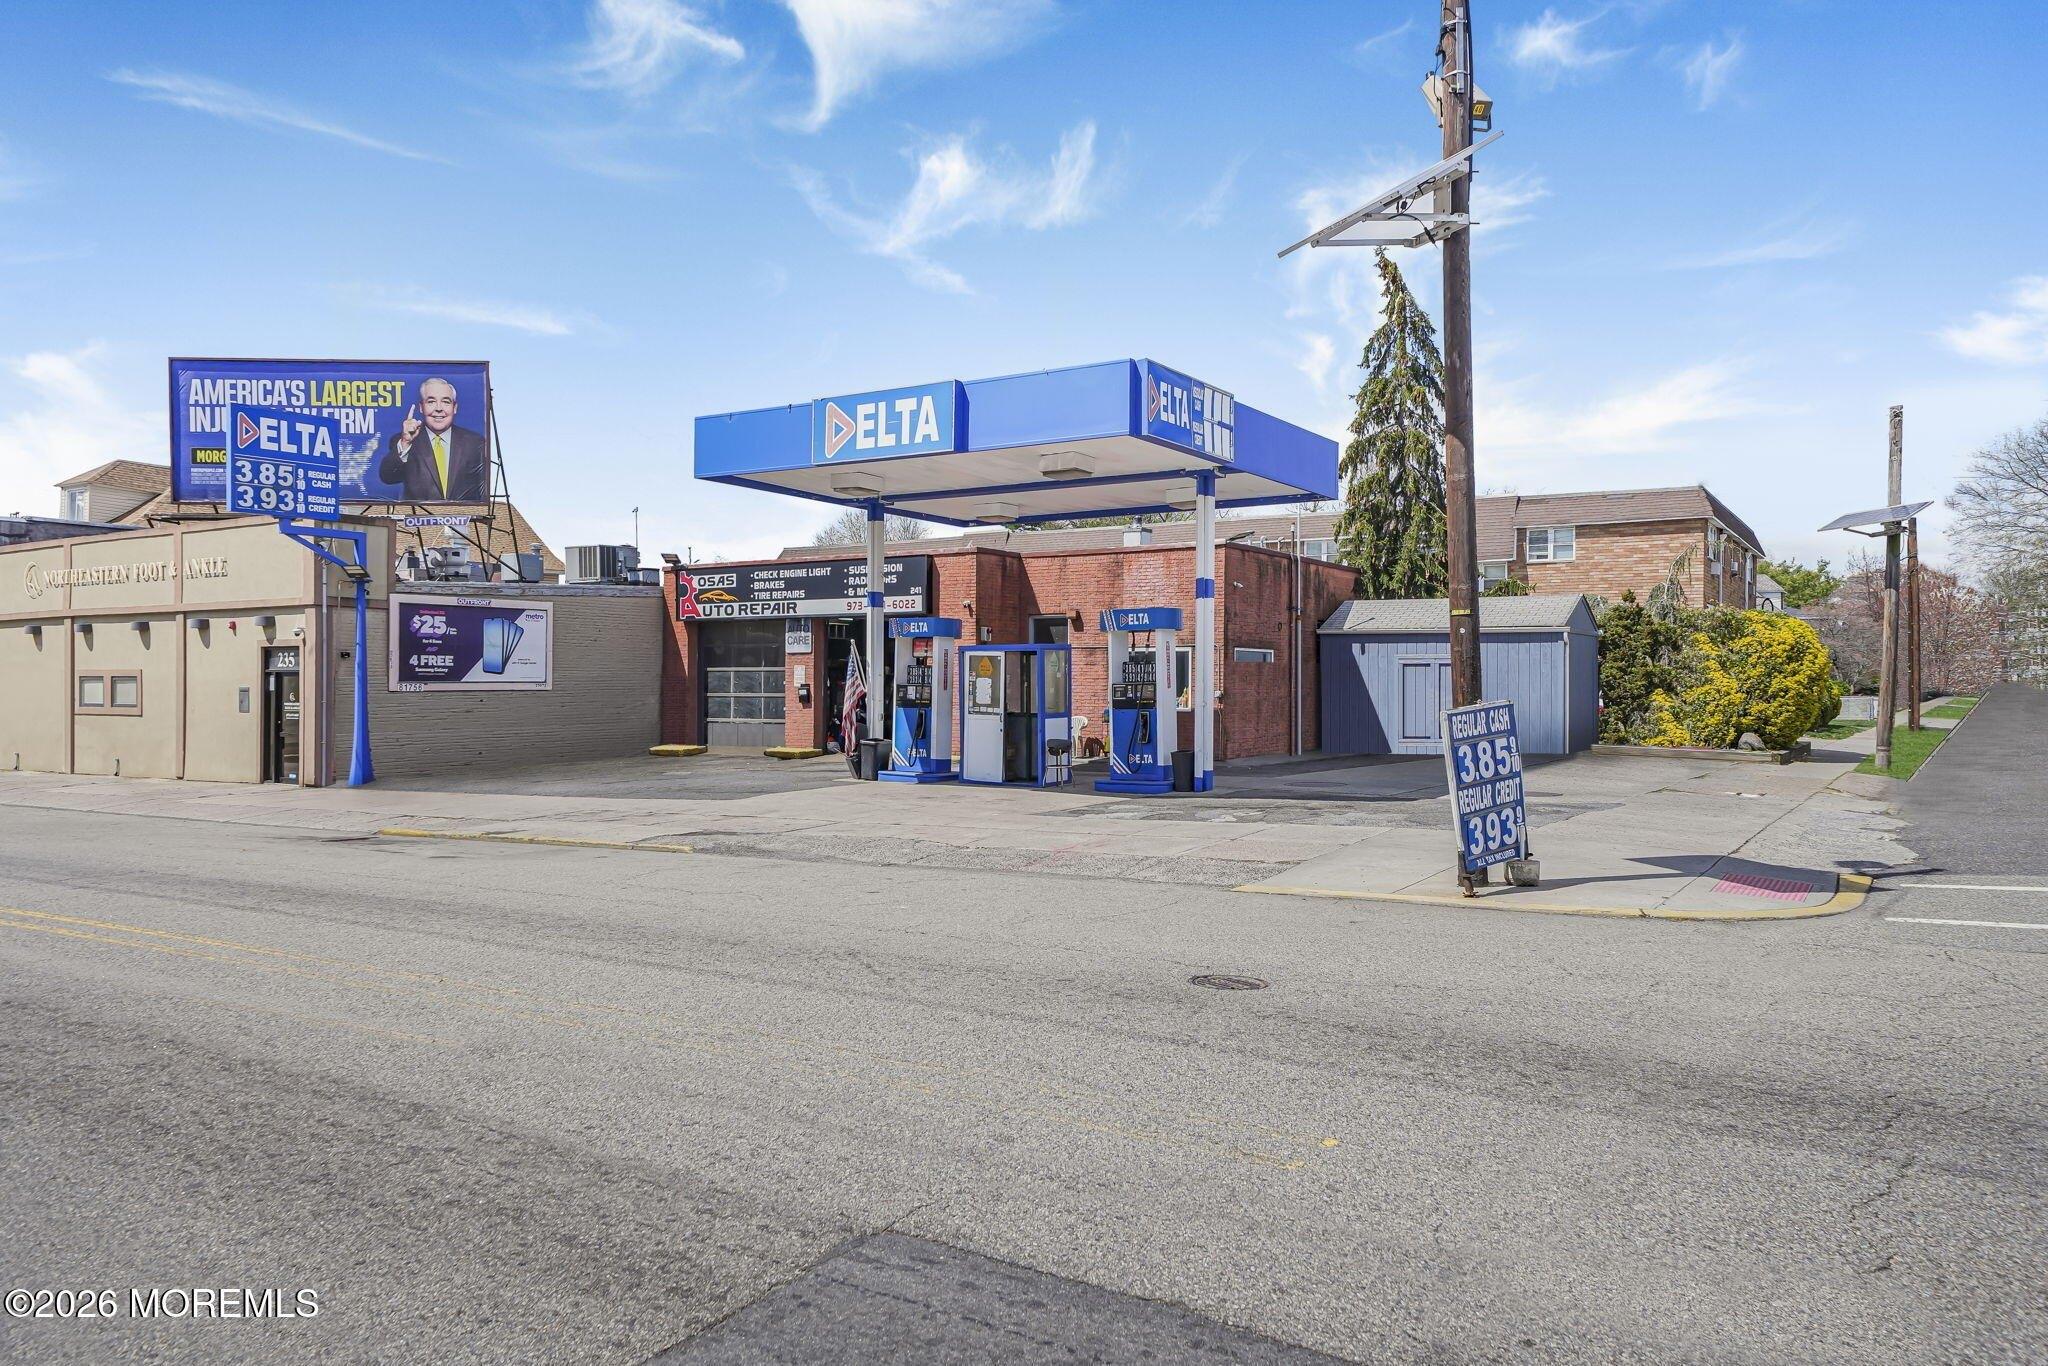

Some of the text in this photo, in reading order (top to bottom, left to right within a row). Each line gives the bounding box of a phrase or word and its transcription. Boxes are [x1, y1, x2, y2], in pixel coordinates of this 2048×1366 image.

[189, 379, 405, 406] AMERICA'S LARGEST
[235, 460, 293, 487] 3.85
[308, 470, 336, 481] REGULAR
[311, 480, 332, 489] CASH
[237, 485, 295, 511] 3.93
[308, 495, 336, 505] REGULAR
[308, 505, 336, 514] CREDIT
[406, 517, 468, 527] OUTFRONT
[133, 561, 167, 583] FOOT
[754, 567, 832, 579] CHECK ENGINE LIGHT
[848, 563, 903, 575] SUSSION
[754, 581, 785, 589] BRAKES
[910, 586, 922, 594] 241
[754, 590, 805, 600] TIRE REPAIRS
[738, 601, 798, 616] REPAIR
[787, 635, 810, 645] CARE
[277, 652, 295, 668] 235
[409, 655, 454, 666] 4 FREE
[1452, 707, 1511, 740] REGULAR CASH
[1458, 737, 1512, 783] 3.85
[1458, 777, 1521, 815] REGULAR CREDIT
[1476, 857, 1486, 866] ALL
